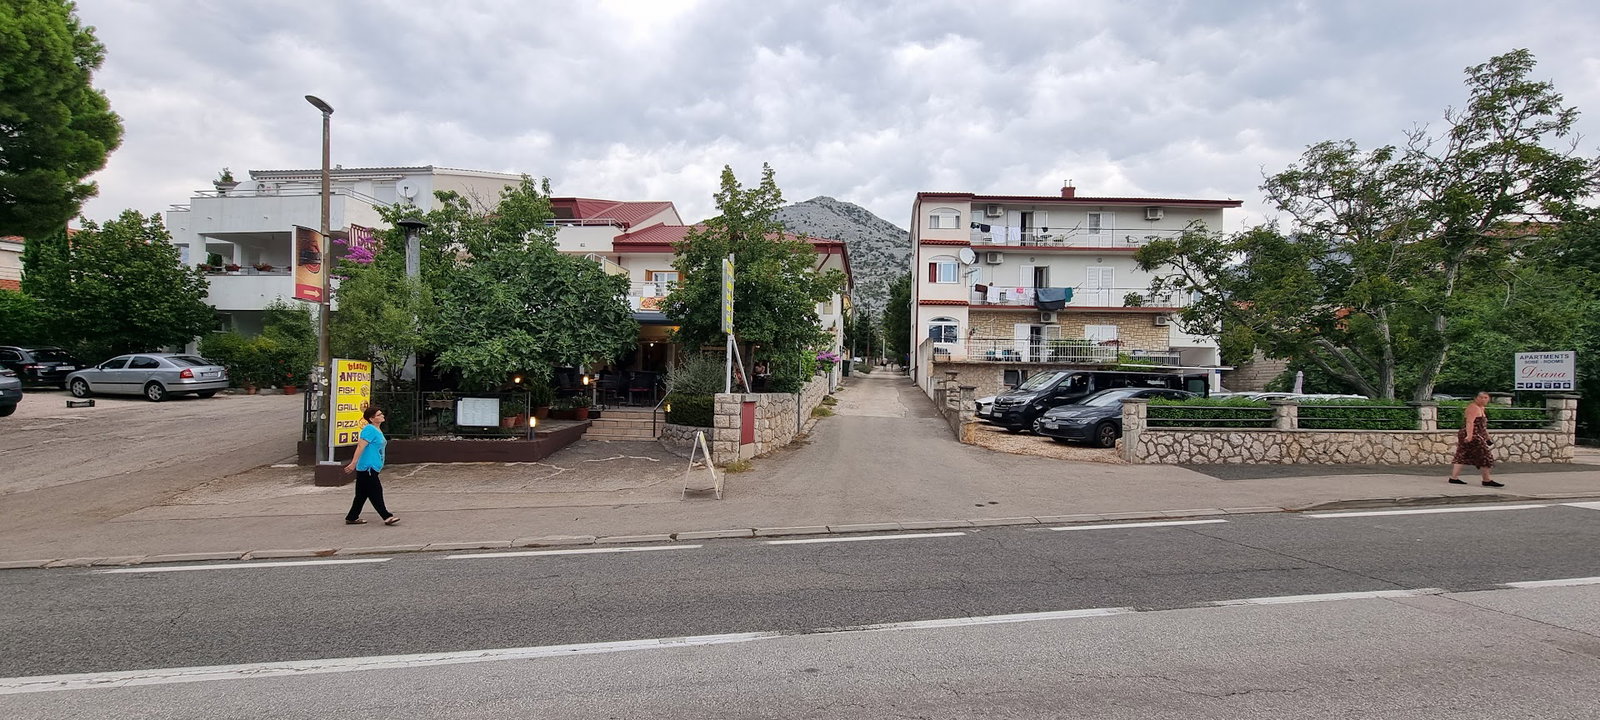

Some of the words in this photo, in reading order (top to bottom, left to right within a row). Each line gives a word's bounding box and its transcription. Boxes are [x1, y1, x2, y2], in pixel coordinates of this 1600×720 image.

[347, 363, 367, 371] bistro
[1521, 365, 1566, 378] Diana
[337, 420, 358, 428] PIZZA
